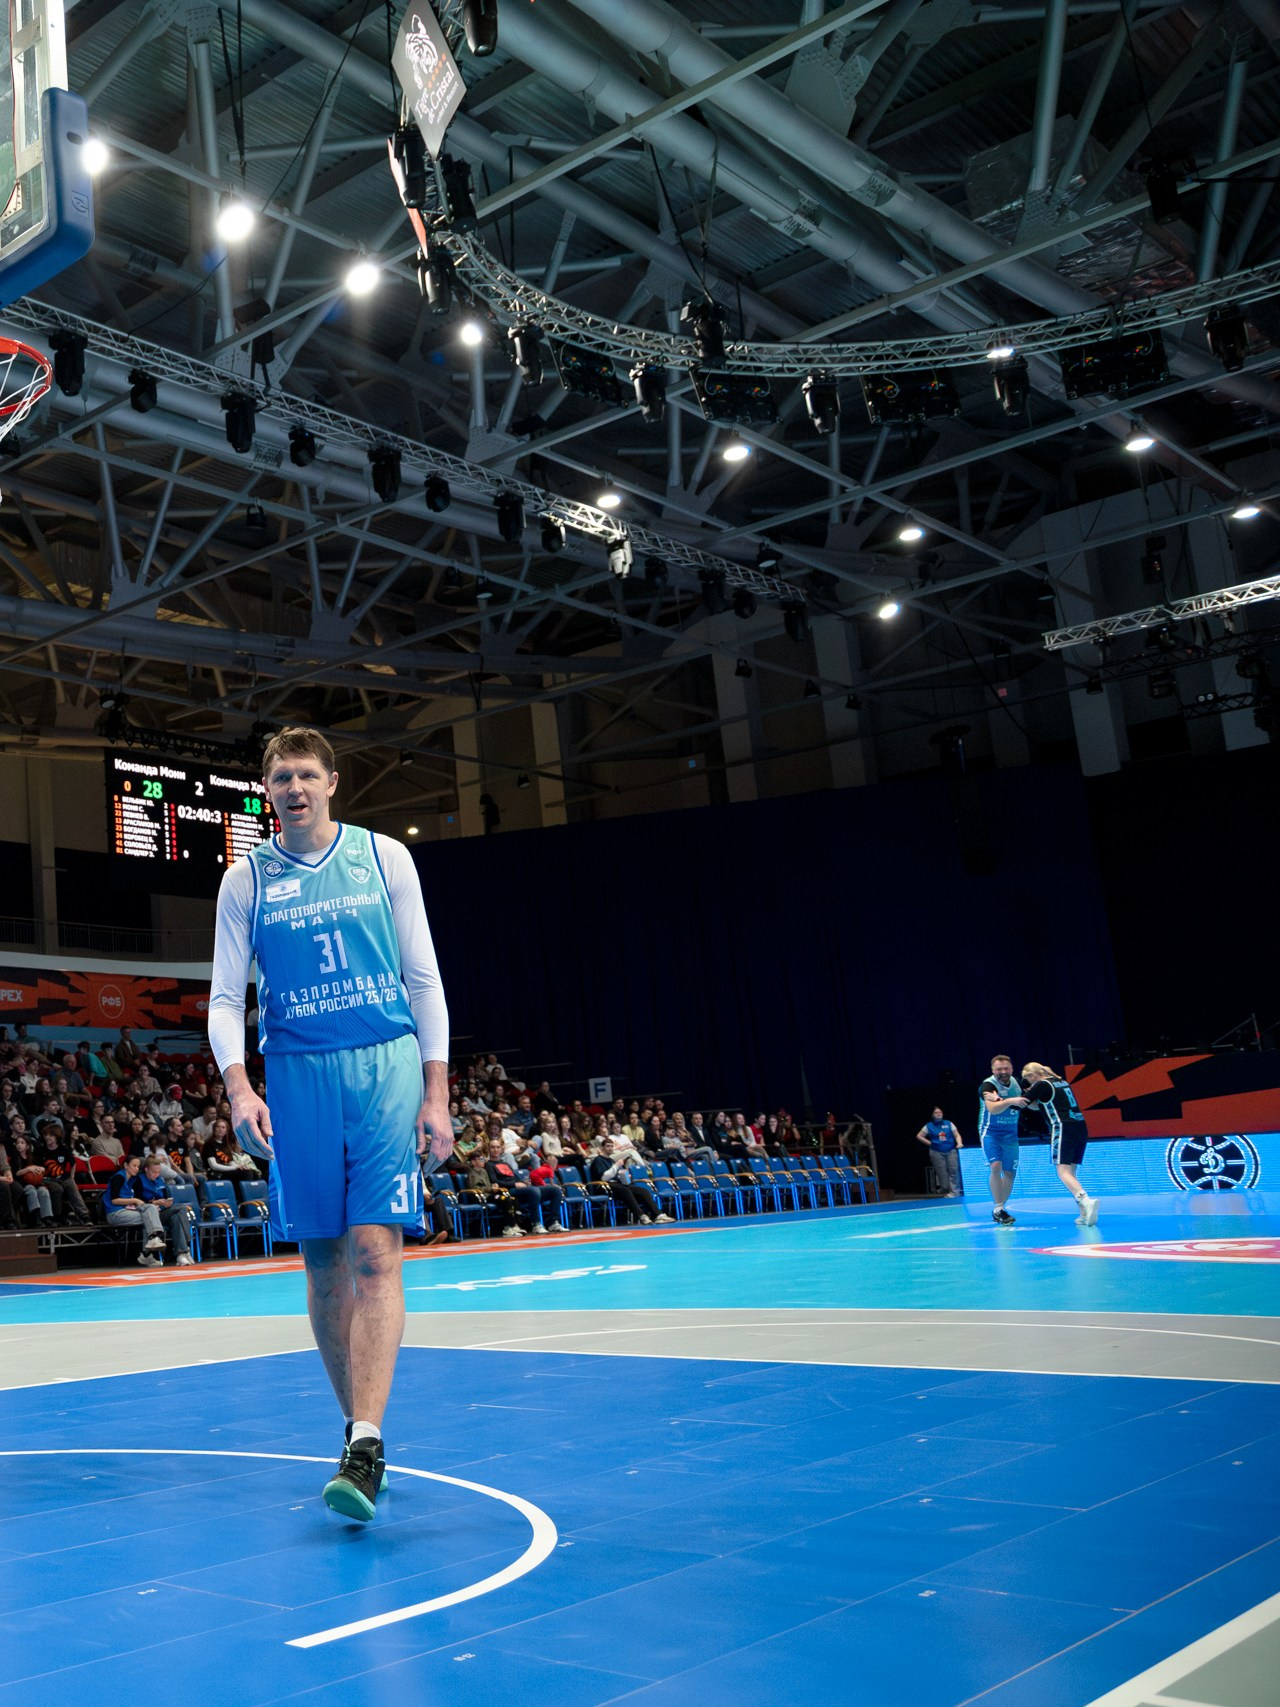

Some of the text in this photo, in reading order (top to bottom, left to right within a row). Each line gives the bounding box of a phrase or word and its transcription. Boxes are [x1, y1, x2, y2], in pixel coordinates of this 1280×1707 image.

[430, 61, 454, 110] Cristal
[114, 758, 186, 780] Команда Мони
[209, 774, 249, 791] Команда
[123, 780, 271, 815] 0 28 2 18 3
[177, 805, 222, 824] 02:40:3
[263, 892, 382, 926] БЛАГОТВОРИТЕЛЬНЫЙ
[290, 908, 358, 930] МАТЧ
[313, 929, 348, 974] 31
[101, 996, 122, 1007] РФБ
[280, 971, 397, 1006] ГАЗПРОМБАНК
[319, 993, 364, 1014] РОССИИ
[365, 988, 398, 1005] 25/26
[594, 1082, 606, 1098] F
[390, 1172, 418, 1213] 31
